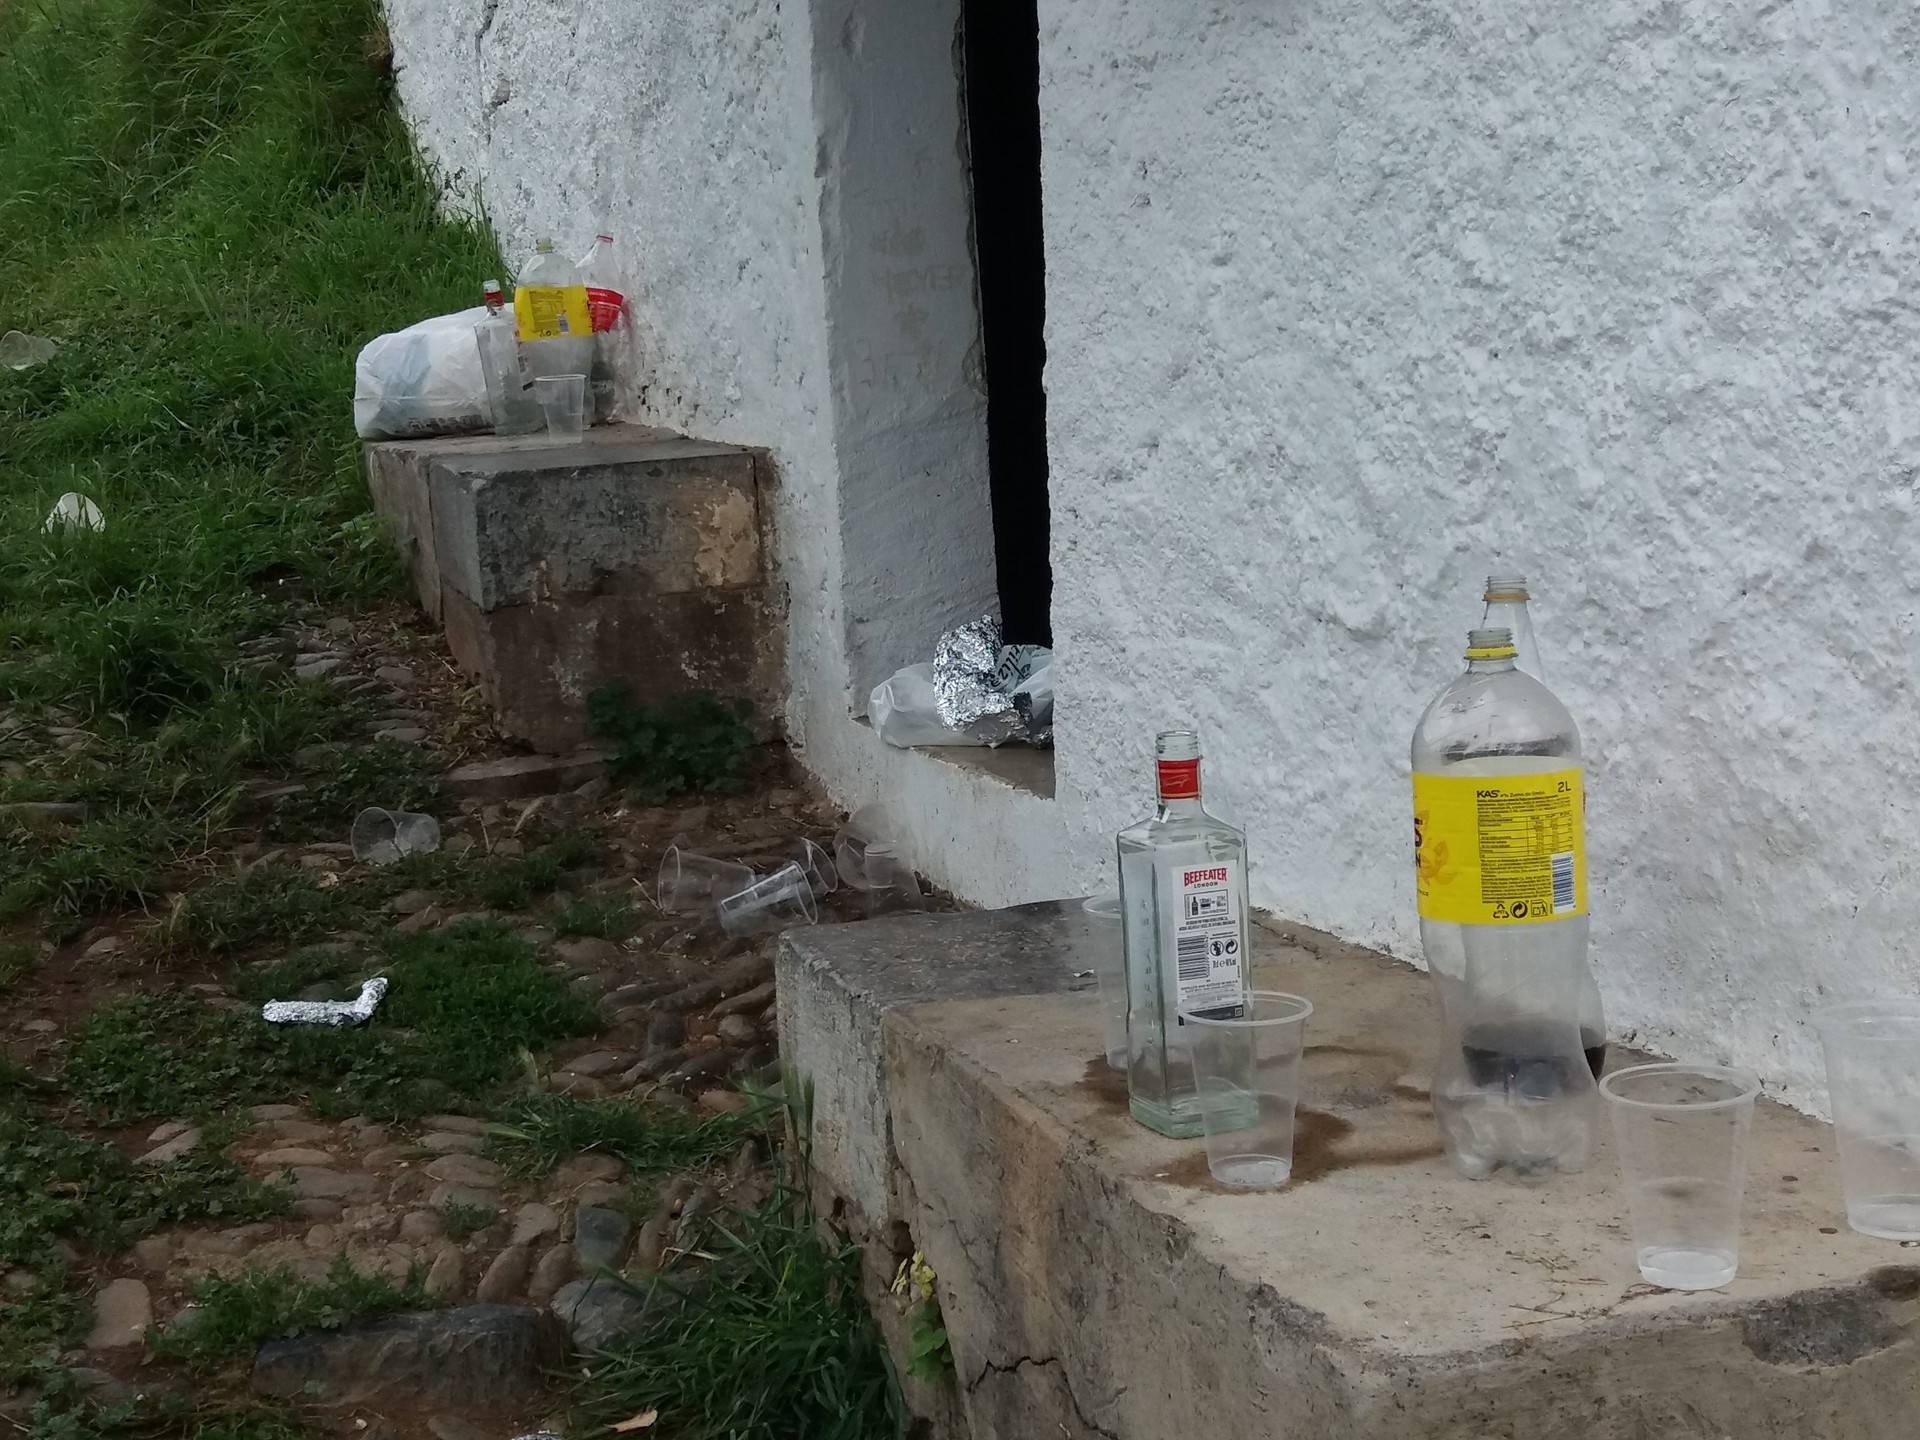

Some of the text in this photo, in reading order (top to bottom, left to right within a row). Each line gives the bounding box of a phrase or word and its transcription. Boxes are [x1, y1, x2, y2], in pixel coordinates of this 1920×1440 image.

[1557, 781, 1571, 793] 2L
[1476, 789, 1500, 799] KAS
[1183, 867, 1228, 887] BEEFEATER
[1193, 881, 1218, 889] LONDON
